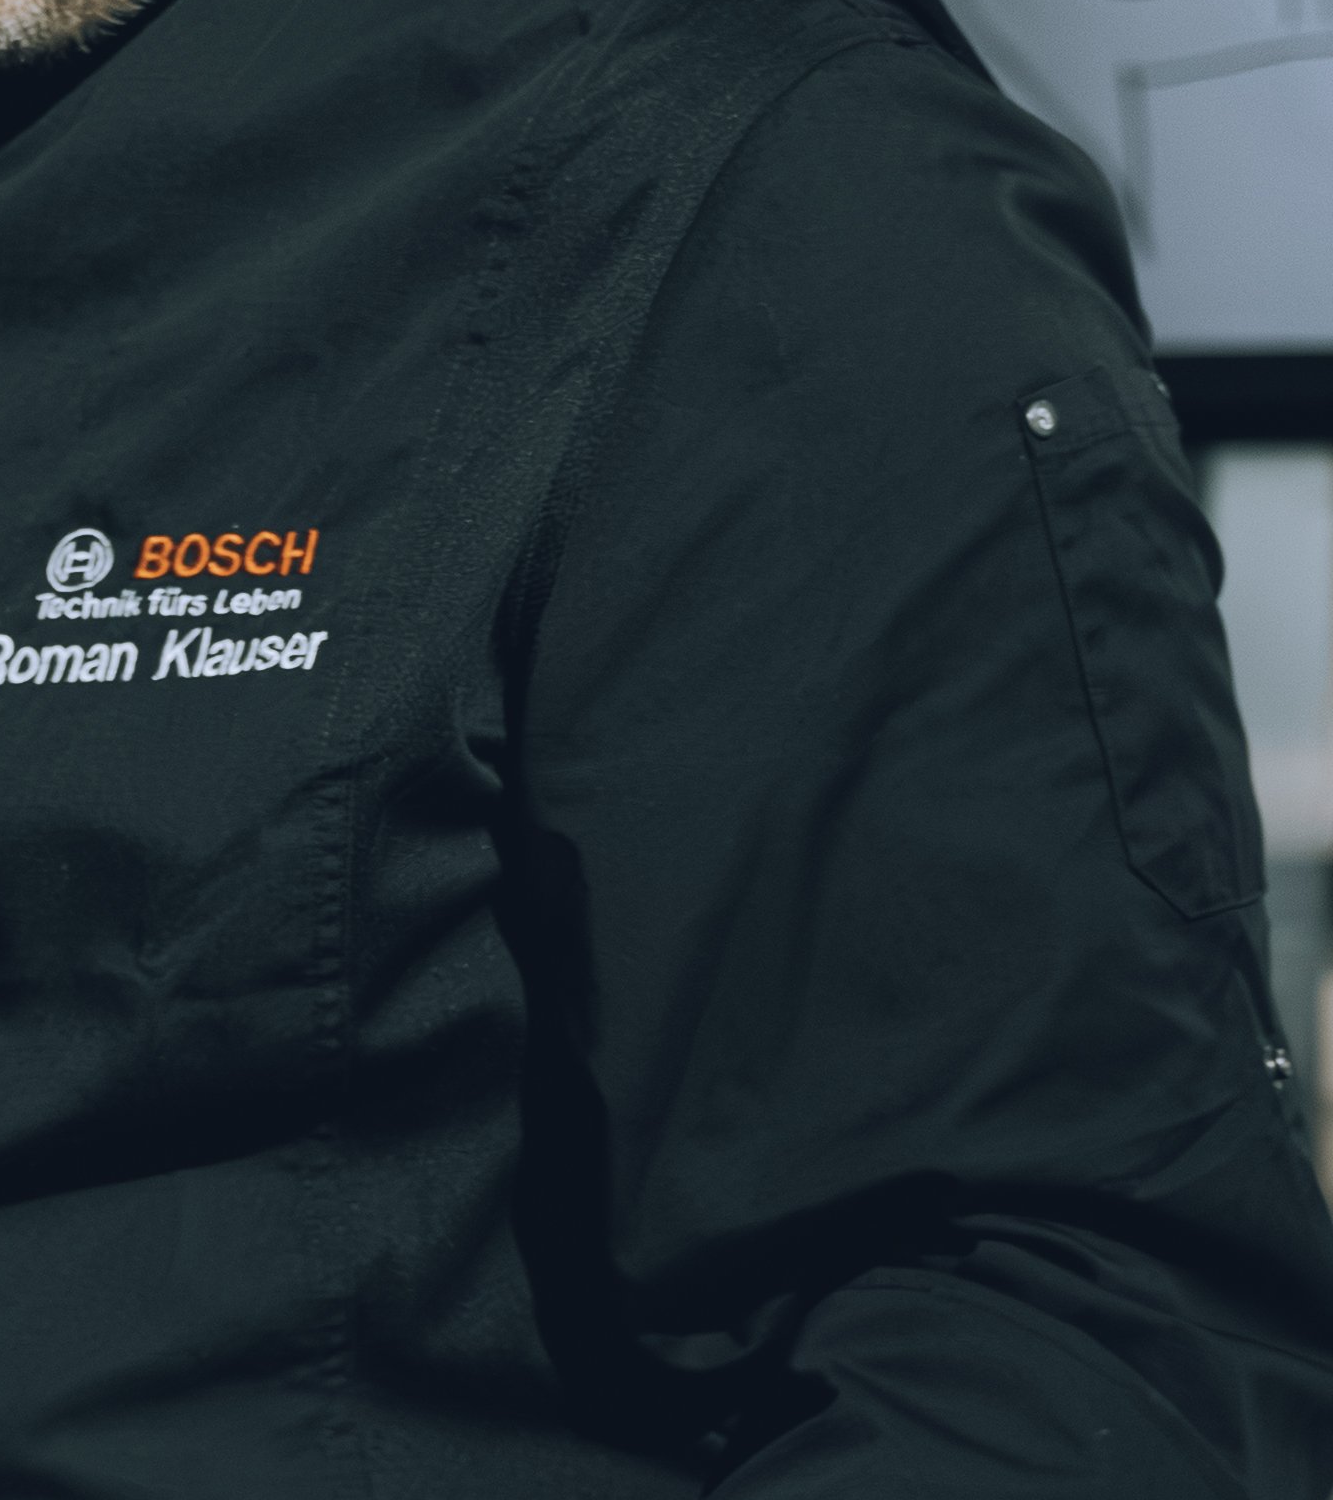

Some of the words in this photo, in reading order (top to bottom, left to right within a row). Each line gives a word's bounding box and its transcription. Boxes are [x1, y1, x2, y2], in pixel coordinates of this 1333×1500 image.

[134, 528, 319, 579] BOSCH
[35, 589, 142, 620] Technik
[148, 586, 208, 617] fürs
[214, 587, 303, 616] Leben
[151, 626, 329, 681] Klauser
